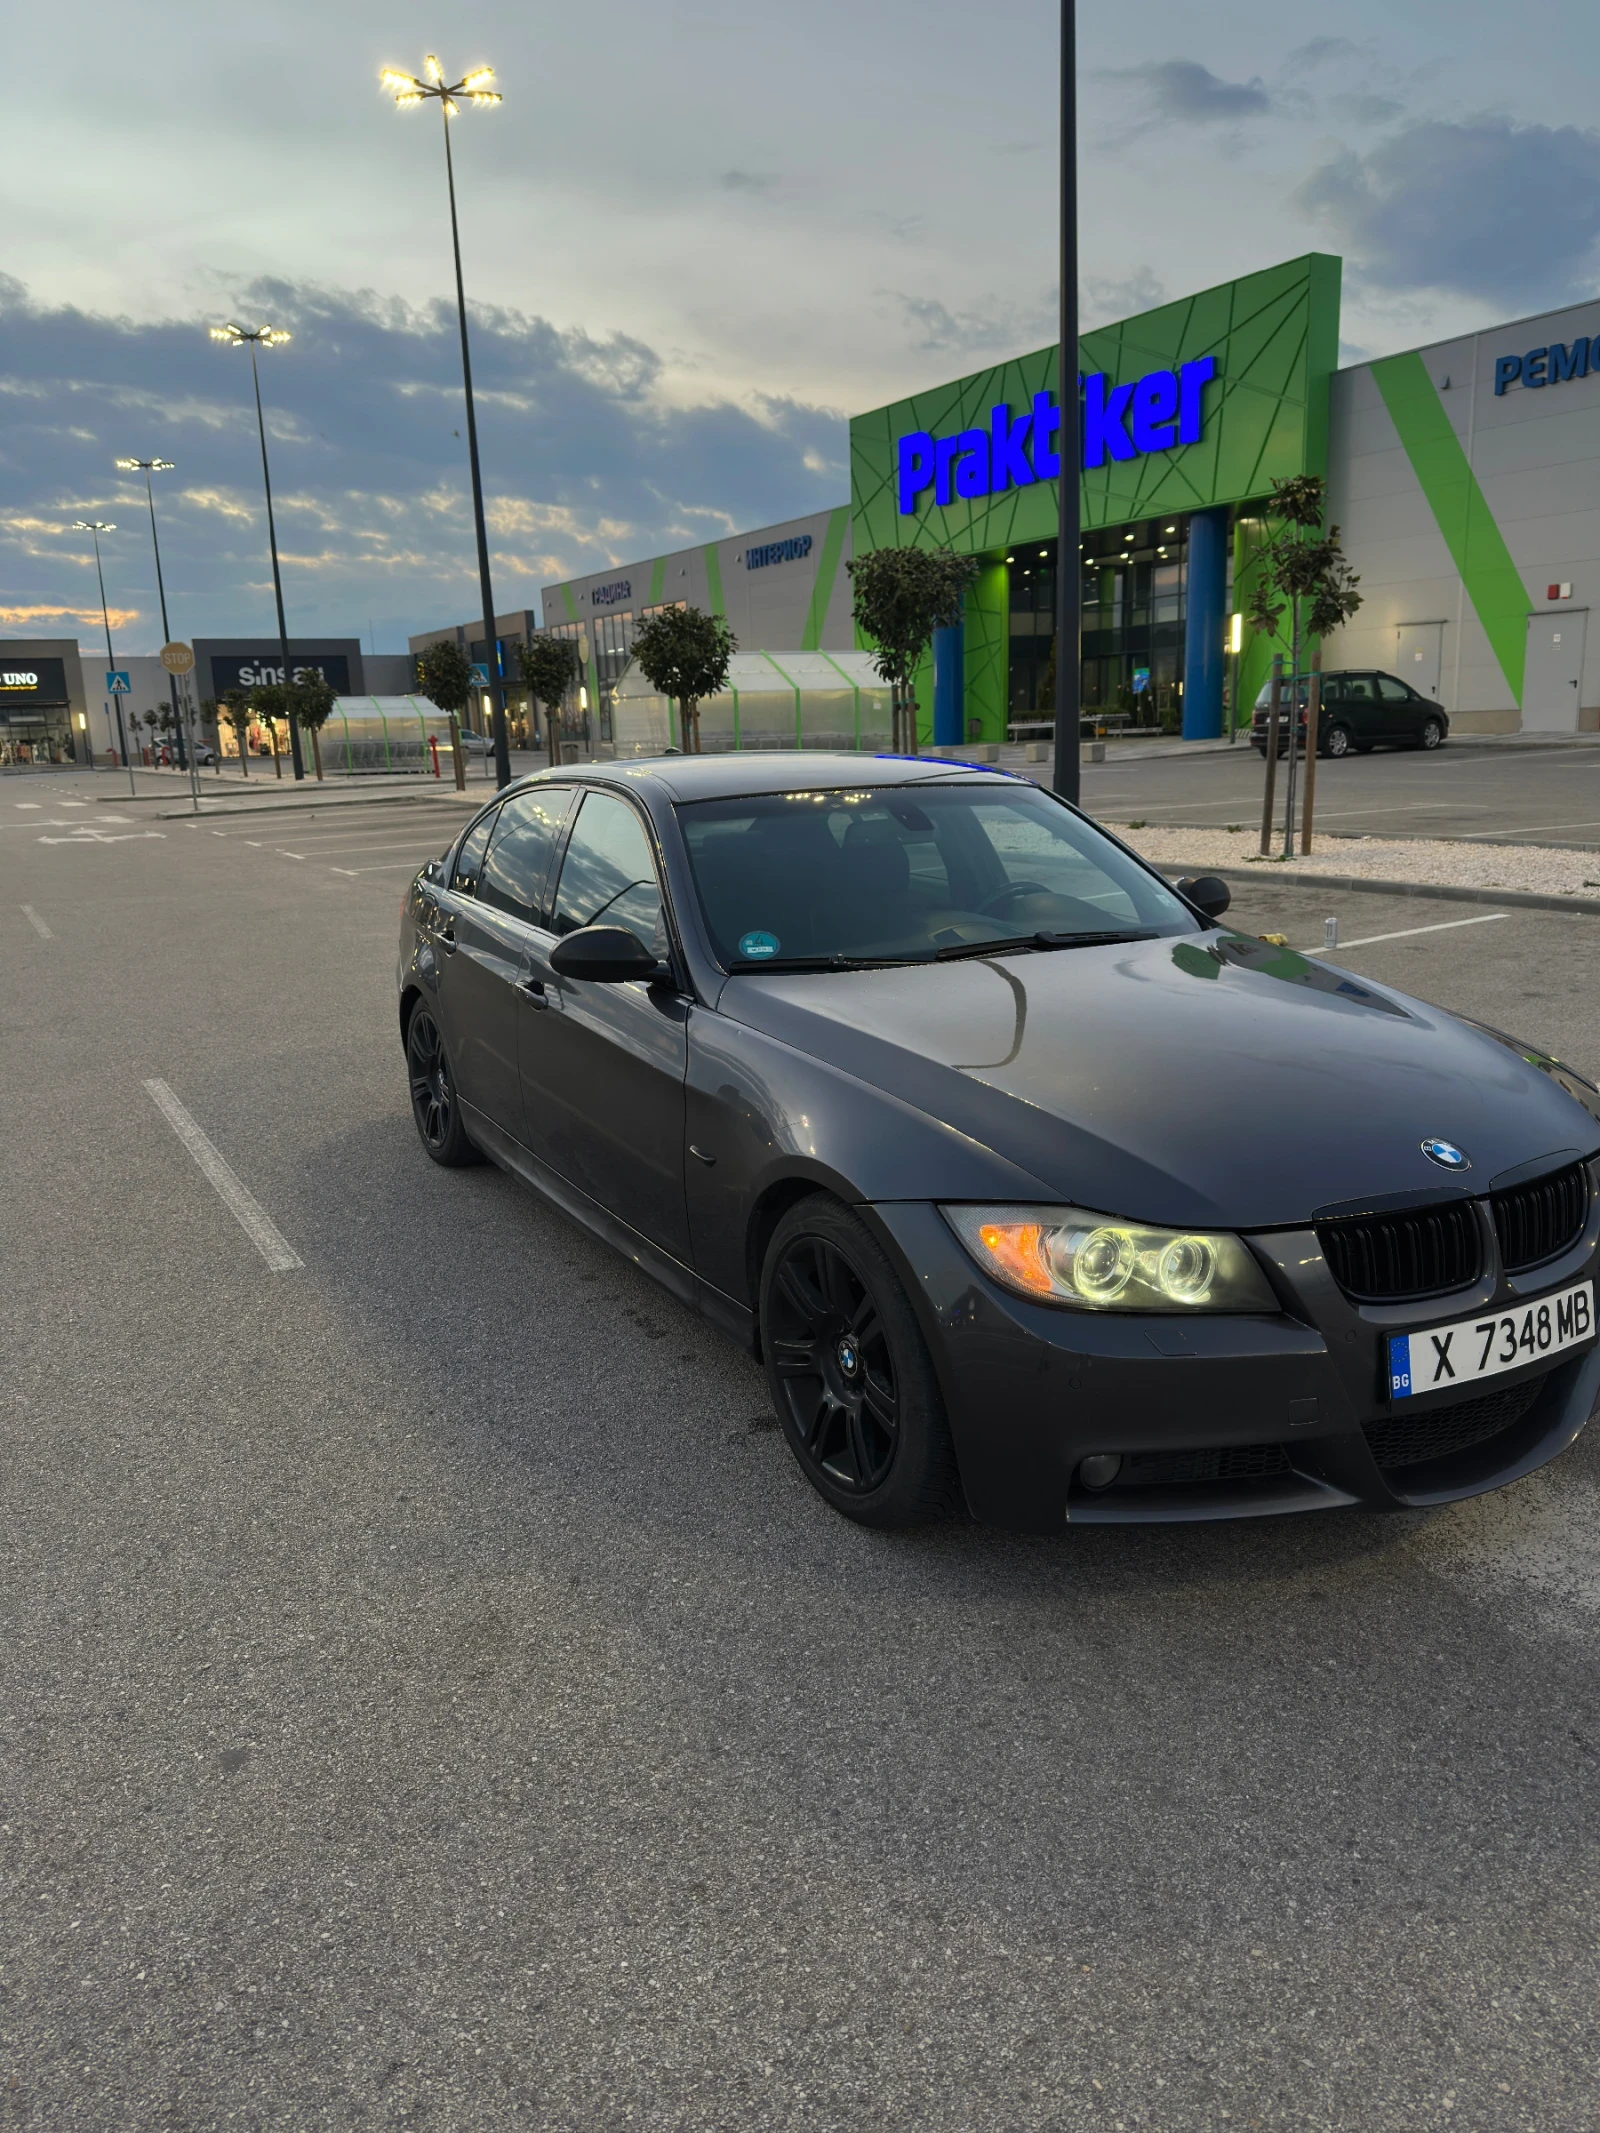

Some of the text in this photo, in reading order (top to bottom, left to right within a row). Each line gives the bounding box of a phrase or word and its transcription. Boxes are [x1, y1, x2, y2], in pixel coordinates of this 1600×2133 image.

[898, 356, 1214, 515] Praktker
[746, 534, 812, 571] ИНТЕРИОР
[164, 653, 190, 665] STOP
[2, 672, 38, 685] UNO
[1431, 1289, 1590, 1382] X 7348 MB
[1392, 1373, 1410, 1390] BG
